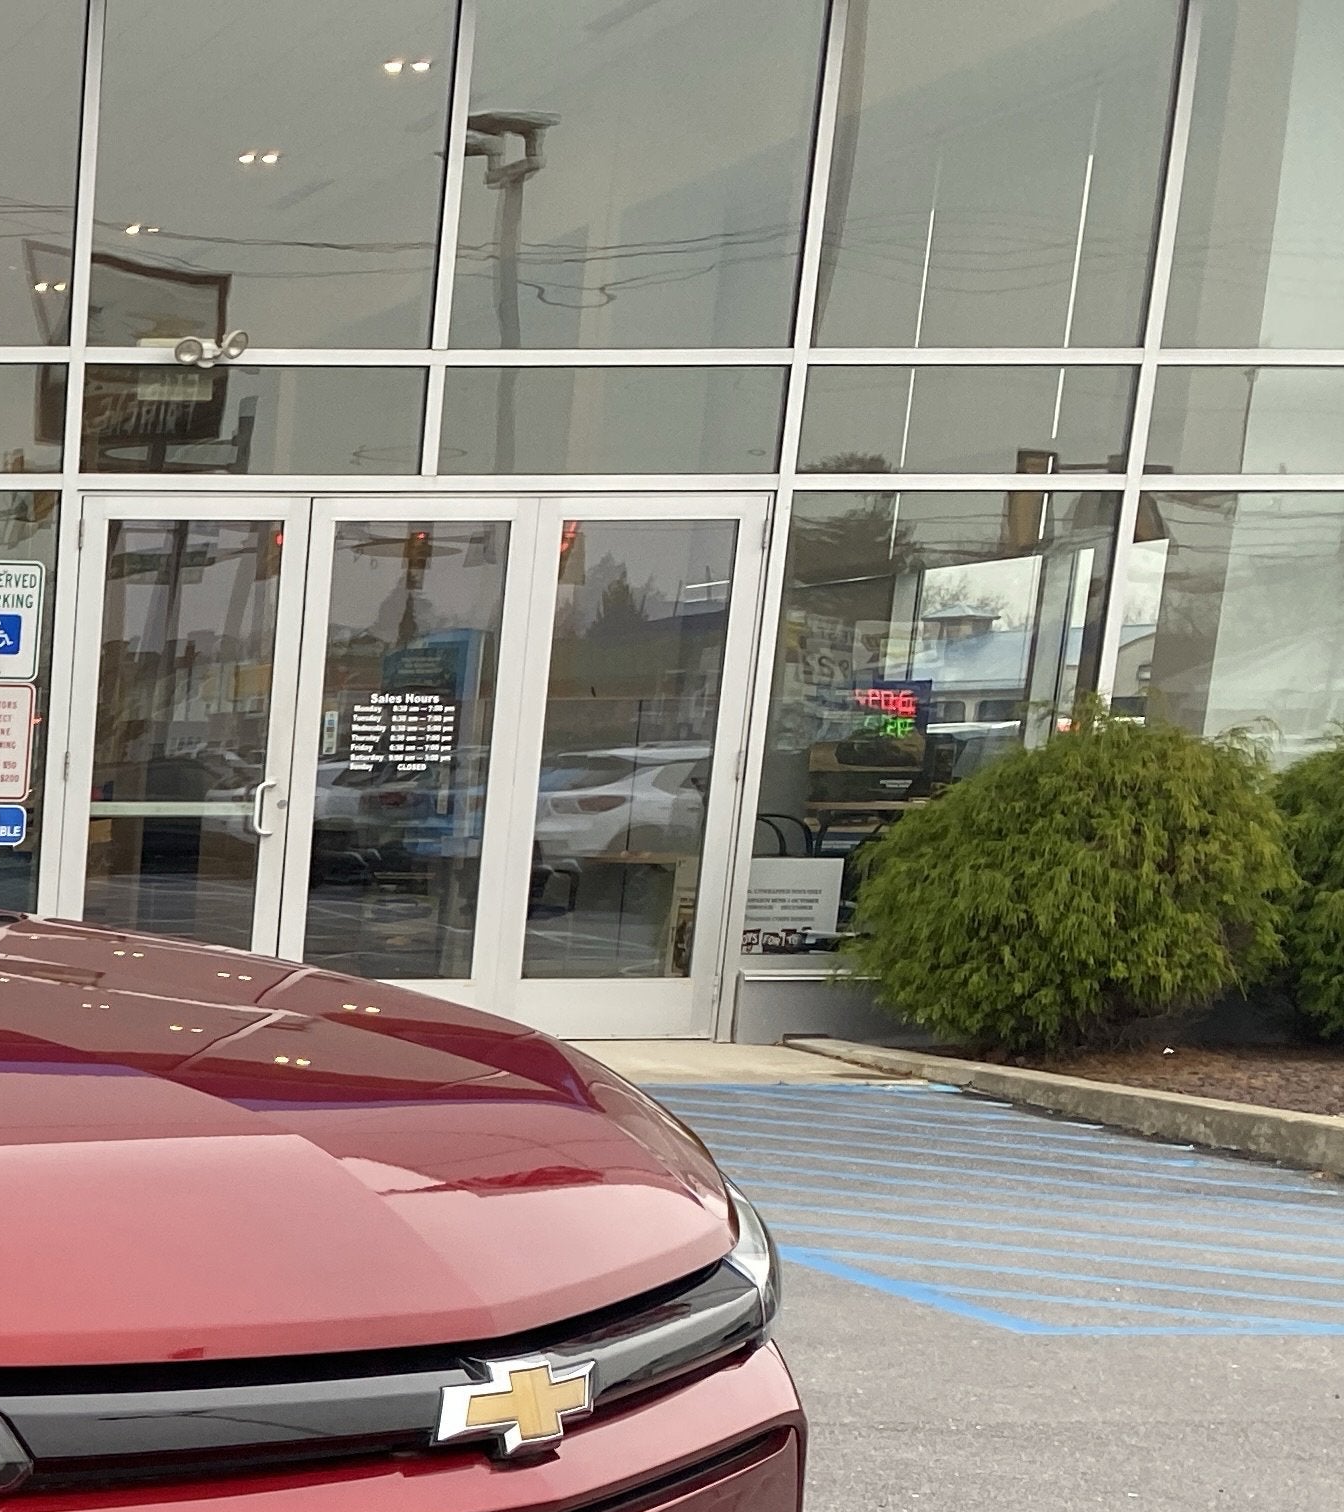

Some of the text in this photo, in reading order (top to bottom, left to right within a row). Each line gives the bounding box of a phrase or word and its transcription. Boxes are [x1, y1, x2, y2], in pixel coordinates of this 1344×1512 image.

[371, 693, 440, 704] Sales Hours
[351, 743, 373, 753] Friday
[3, 761, 17, 769] $50
[397, 763, 427, 771] CLOSED
[0, 774, 20, 783] $200
